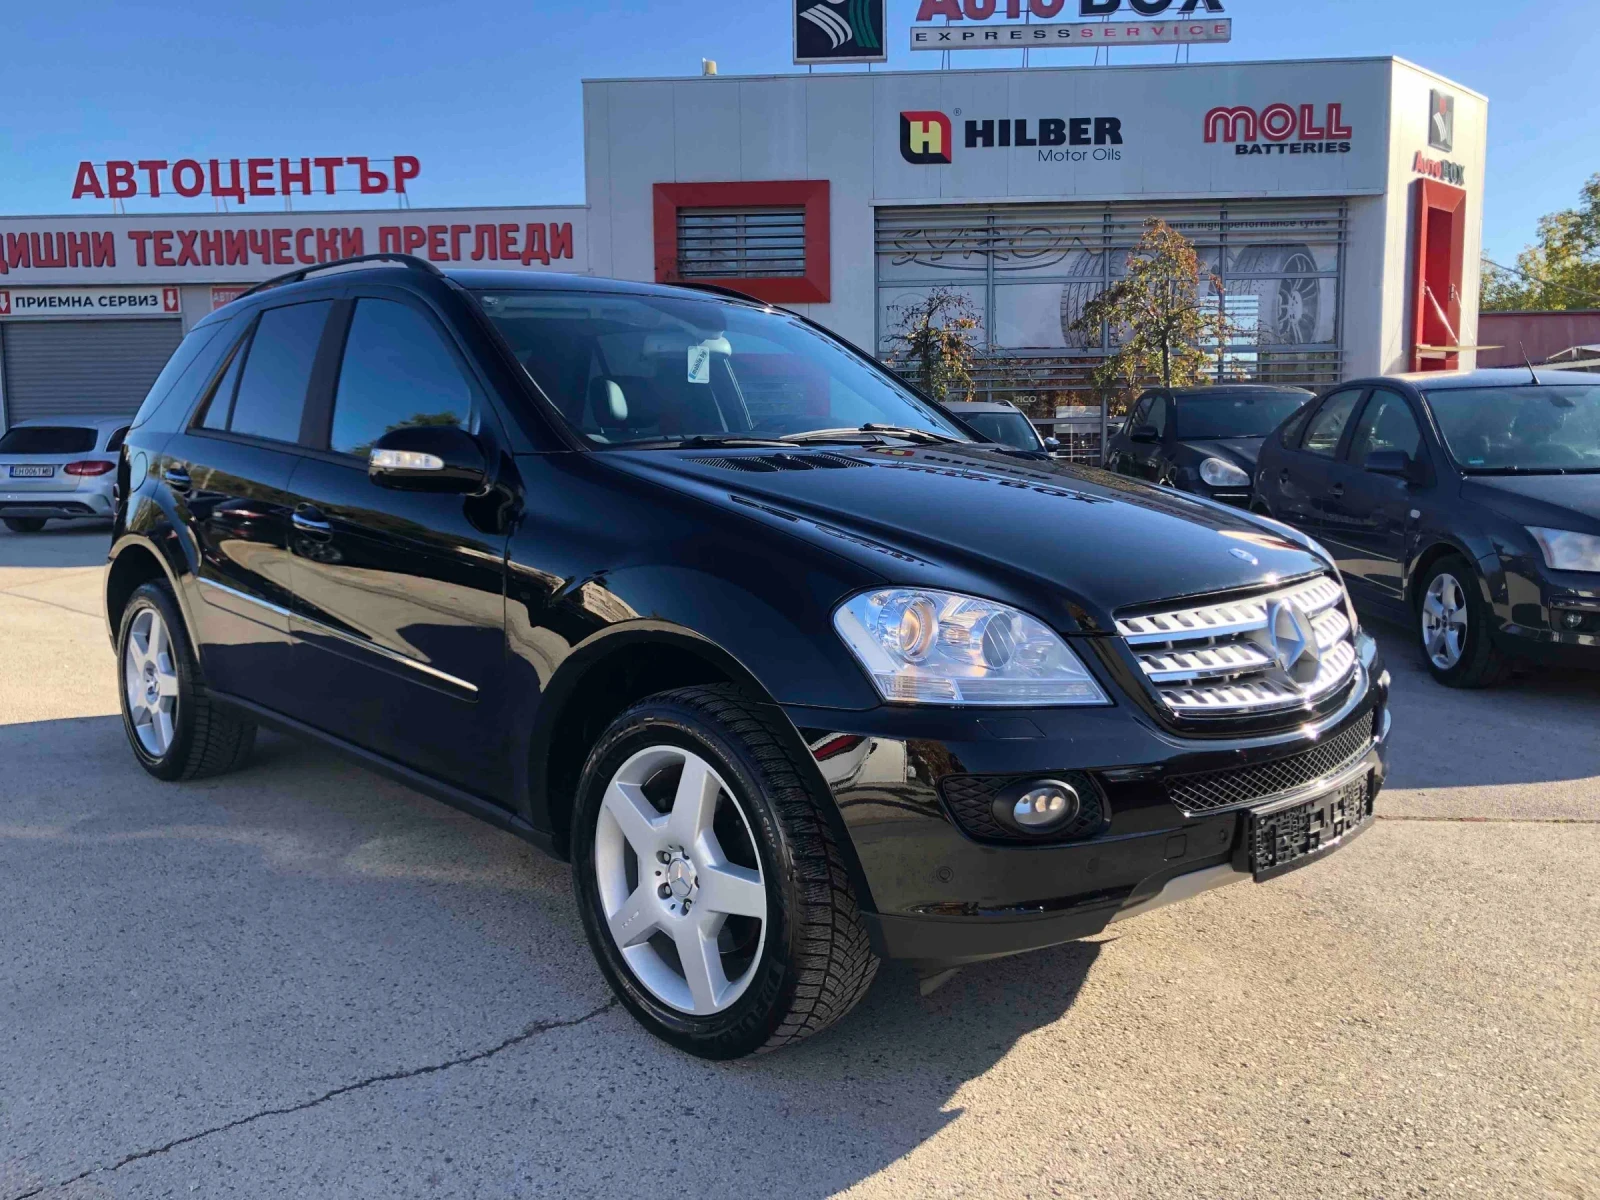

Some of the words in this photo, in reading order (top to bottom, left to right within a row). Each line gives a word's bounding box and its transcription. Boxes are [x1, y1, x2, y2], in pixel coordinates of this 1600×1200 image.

[964, 116, 1123, 148] HILBER
[1038, 149, 1088, 162] Motor
[1092, 148, 1122, 161] Oils
[1235, 141, 1351, 155] BATTERIES
[71, 155, 420, 205] АВТОЦЕНТЪР
[128, 227, 364, 267] ТЕХНИЧЕСКИ
[379, 223, 574, 267] ПРЕГЛЕДИ
[15, 296, 93, 308] ПРИЕМНА
[98, 294, 158, 307] СЕРВИЗ
